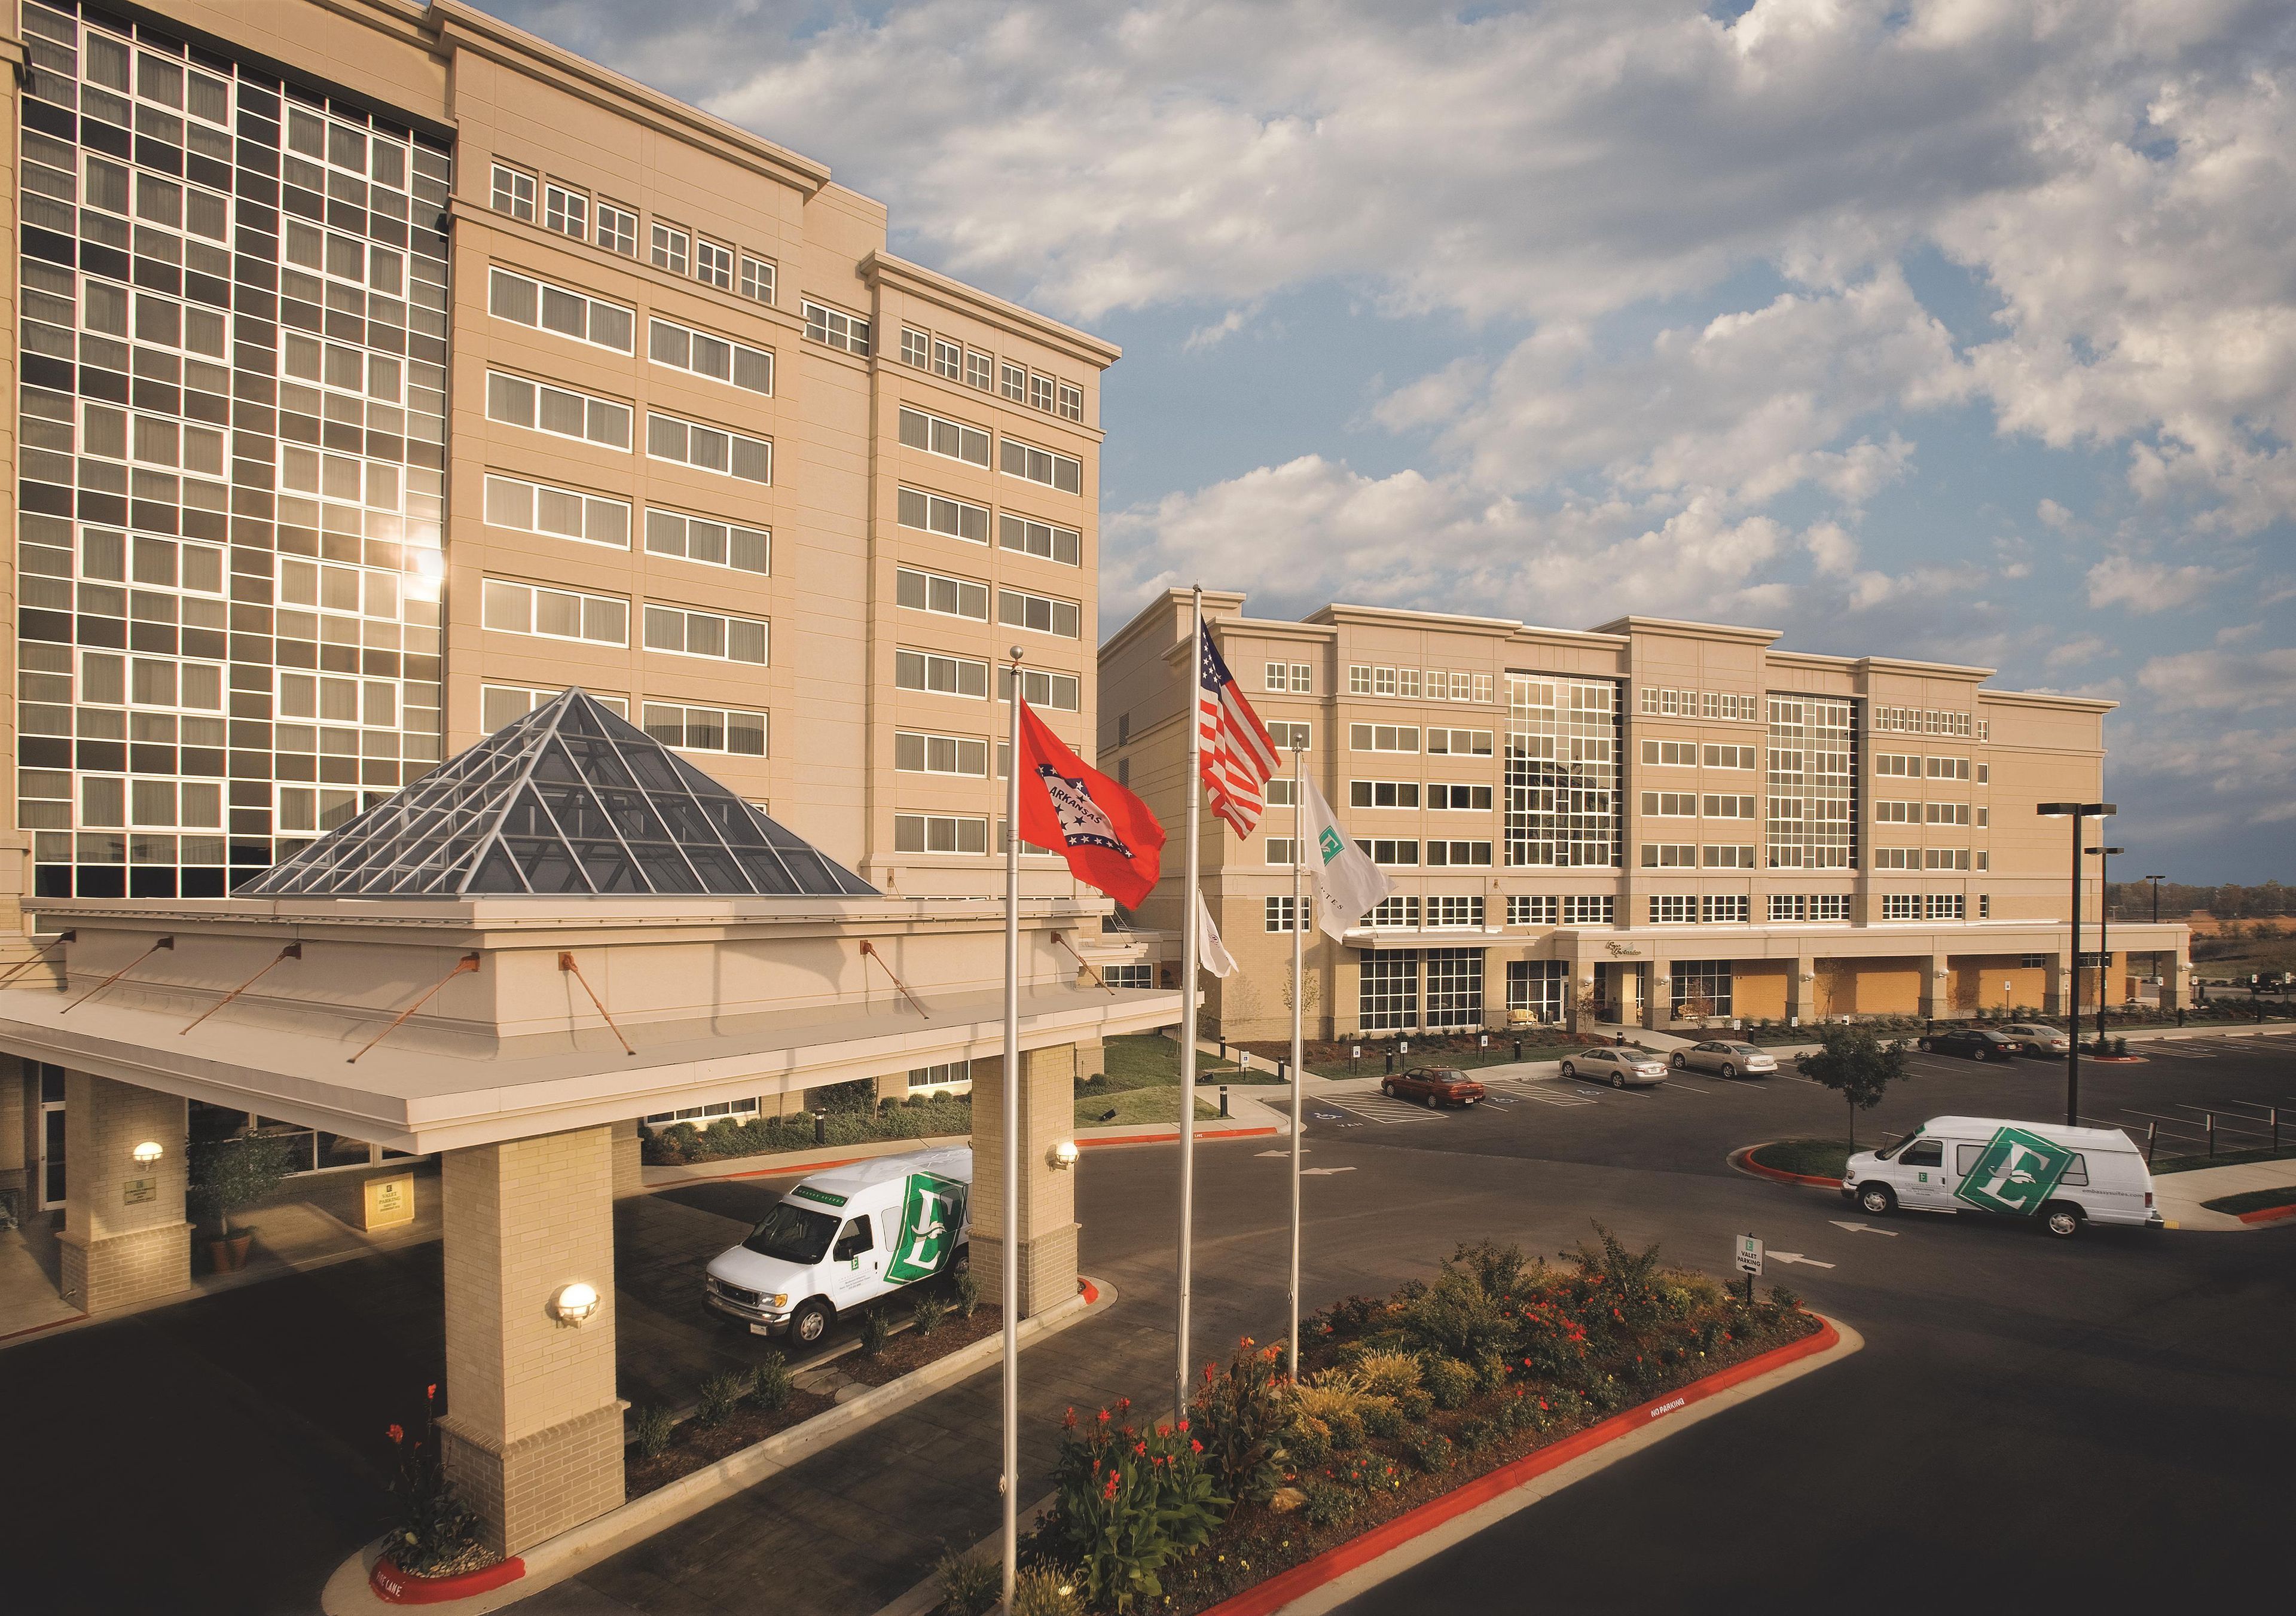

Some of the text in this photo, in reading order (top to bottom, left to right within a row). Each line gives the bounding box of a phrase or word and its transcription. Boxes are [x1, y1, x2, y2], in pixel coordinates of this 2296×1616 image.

[1049, 786, 1102, 824] ARKANSAS
[2082, 1189, 2144, 1198] embassysuites.com
[1737, 1256, 1761, 1266] PARKING
[1741, 1250, 1757, 1259] VALET
[1651, 1398, 1685, 1418] NO PARKING
[386, 1579, 402, 1597] LANE
